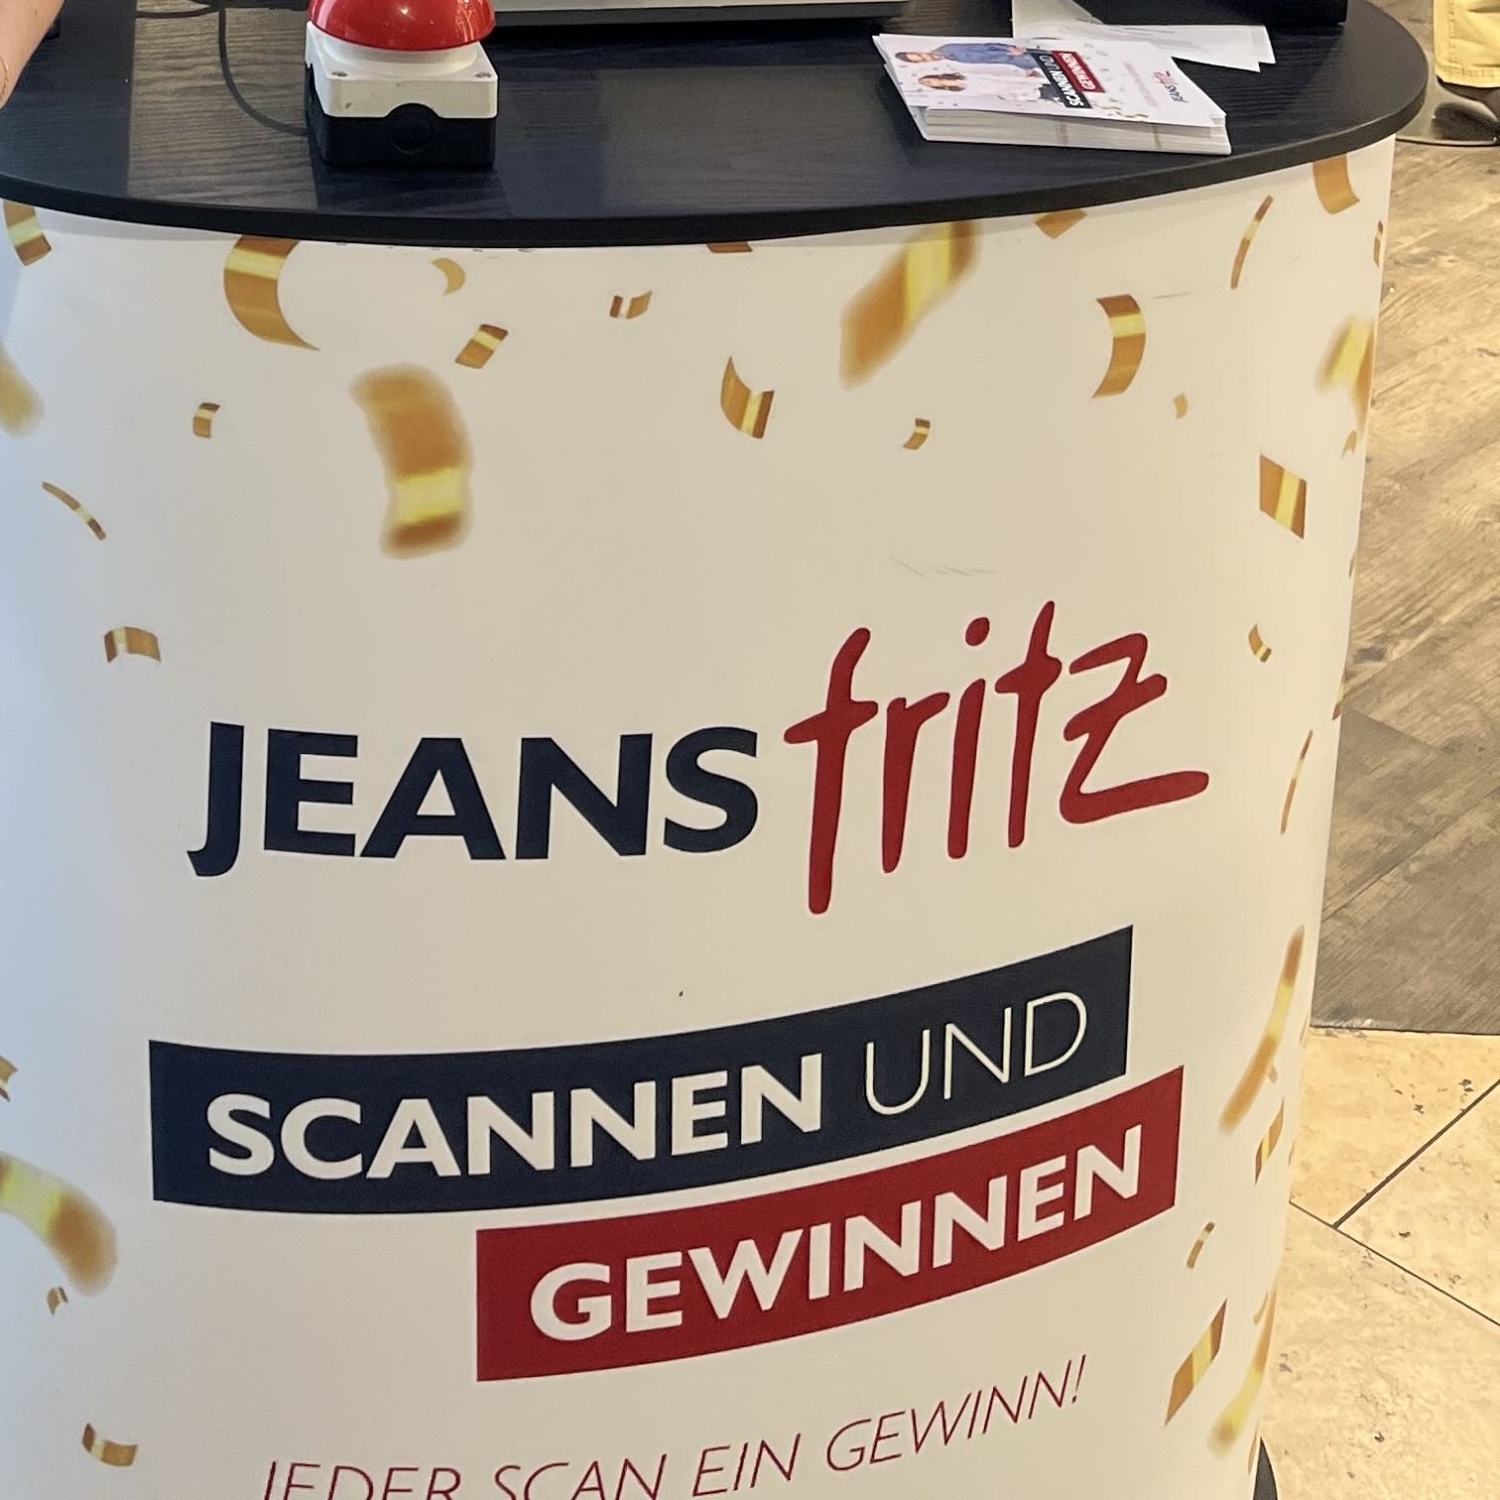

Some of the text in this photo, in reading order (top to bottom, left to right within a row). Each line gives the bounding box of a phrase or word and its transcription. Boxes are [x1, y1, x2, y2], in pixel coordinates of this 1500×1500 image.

[1049, 70, 1084, 107] SCANNEN
[186, 599, 1209, 915] JEANS fritz
[204, 991, 1088, 1181] SCANNEN UND
[528, 1125, 1143, 1343] GEWINNEN
[495, 1453, 668, 1500] SCAN
[691, 1432, 802, 1497] EIN
[825, 1353, 1088, 1473] GEWINN!
